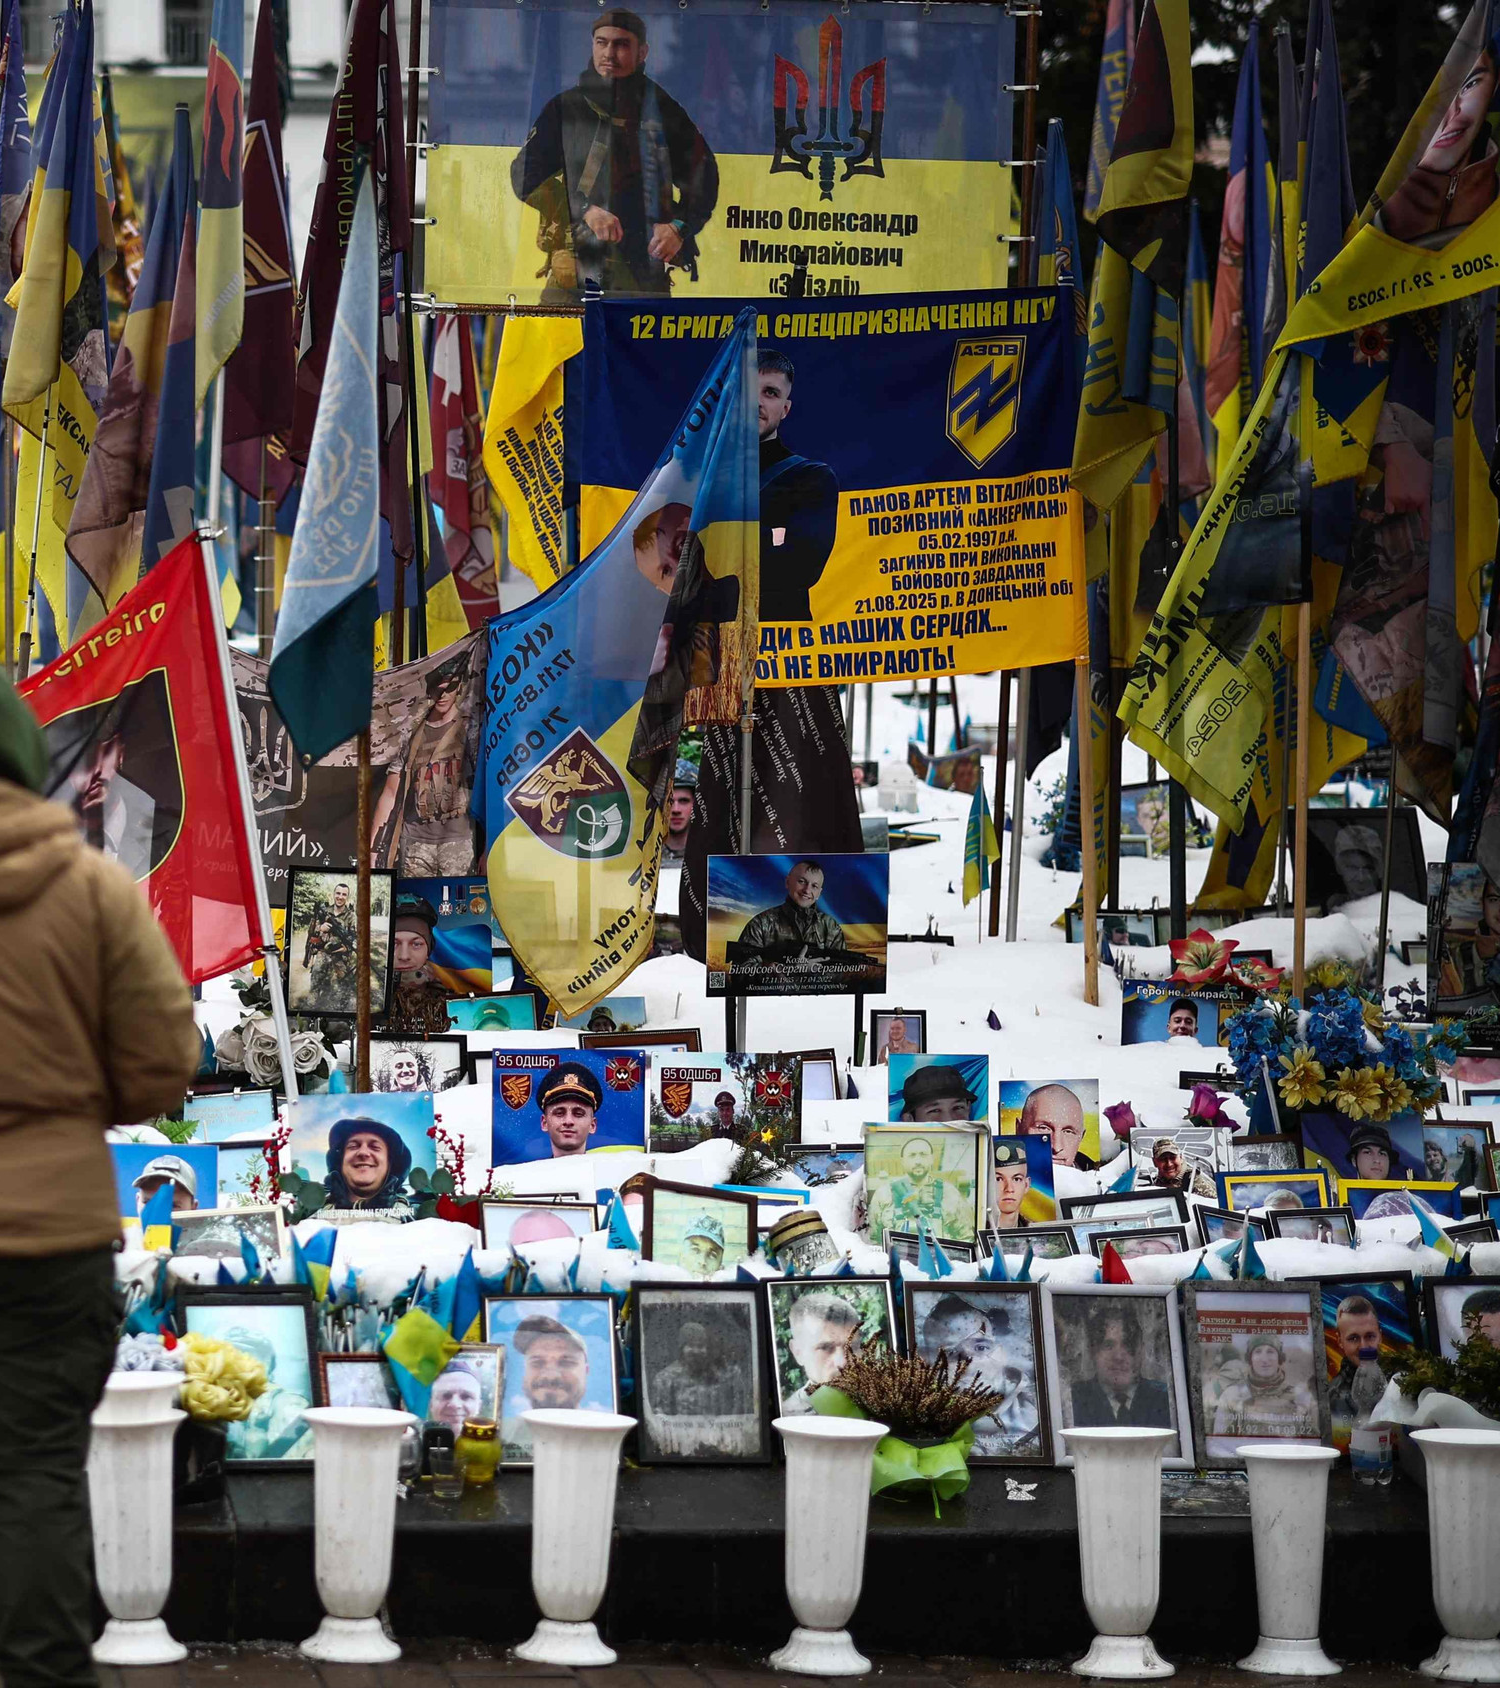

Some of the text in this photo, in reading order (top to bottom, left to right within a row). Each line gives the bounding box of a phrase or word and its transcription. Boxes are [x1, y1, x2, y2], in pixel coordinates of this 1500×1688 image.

[726, 206, 919, 236] Янко Олександр
[768, 273, 860, 298] «Зізді»
[630, 295, 1057, 341] 12 БРИГАА СПЕЦПРИЗНАЧЕННЯ НГУ
[961, 343, 1019, 358] АЗОВ
[849, 474, 1071, 517] ПАНОВ АРТЕМ ВІТАЛІЙОВИ
[867, 498, 1068, 537] ПОЗИВНИЙ «АККЕРМАН»
[918, 530, 1018, 551] 05.02.1997 р.н.
[878, 541, 1057, 575] ЗАГИНУВ ПРИ ВИКОНАННІ
[891, 562, 1046, 592] БОЙОВОГО ЗАВДАННЯ
[854, 593, 938, 616] 21.08.2025
[940, 594, 954, 610] р.
[966, 578, 1048, 607] ДОНЕЦЬКІЙ
[758, 623, 793, 655] ДИ
[798, 625, 815, 648] В
[820, 615, 906, 646] НАШИХ
[785, 652, 813, 680] НЕ
[817, 645, 956, 677] ВМИРАЮТЬ!
[728, 963, 867, 975] Білоусов Сергій Сергійович
[498, 1053, 556, 1071] 95 ОДШБр
[662, 1068, 718, 1082] 95 ОДШБр
